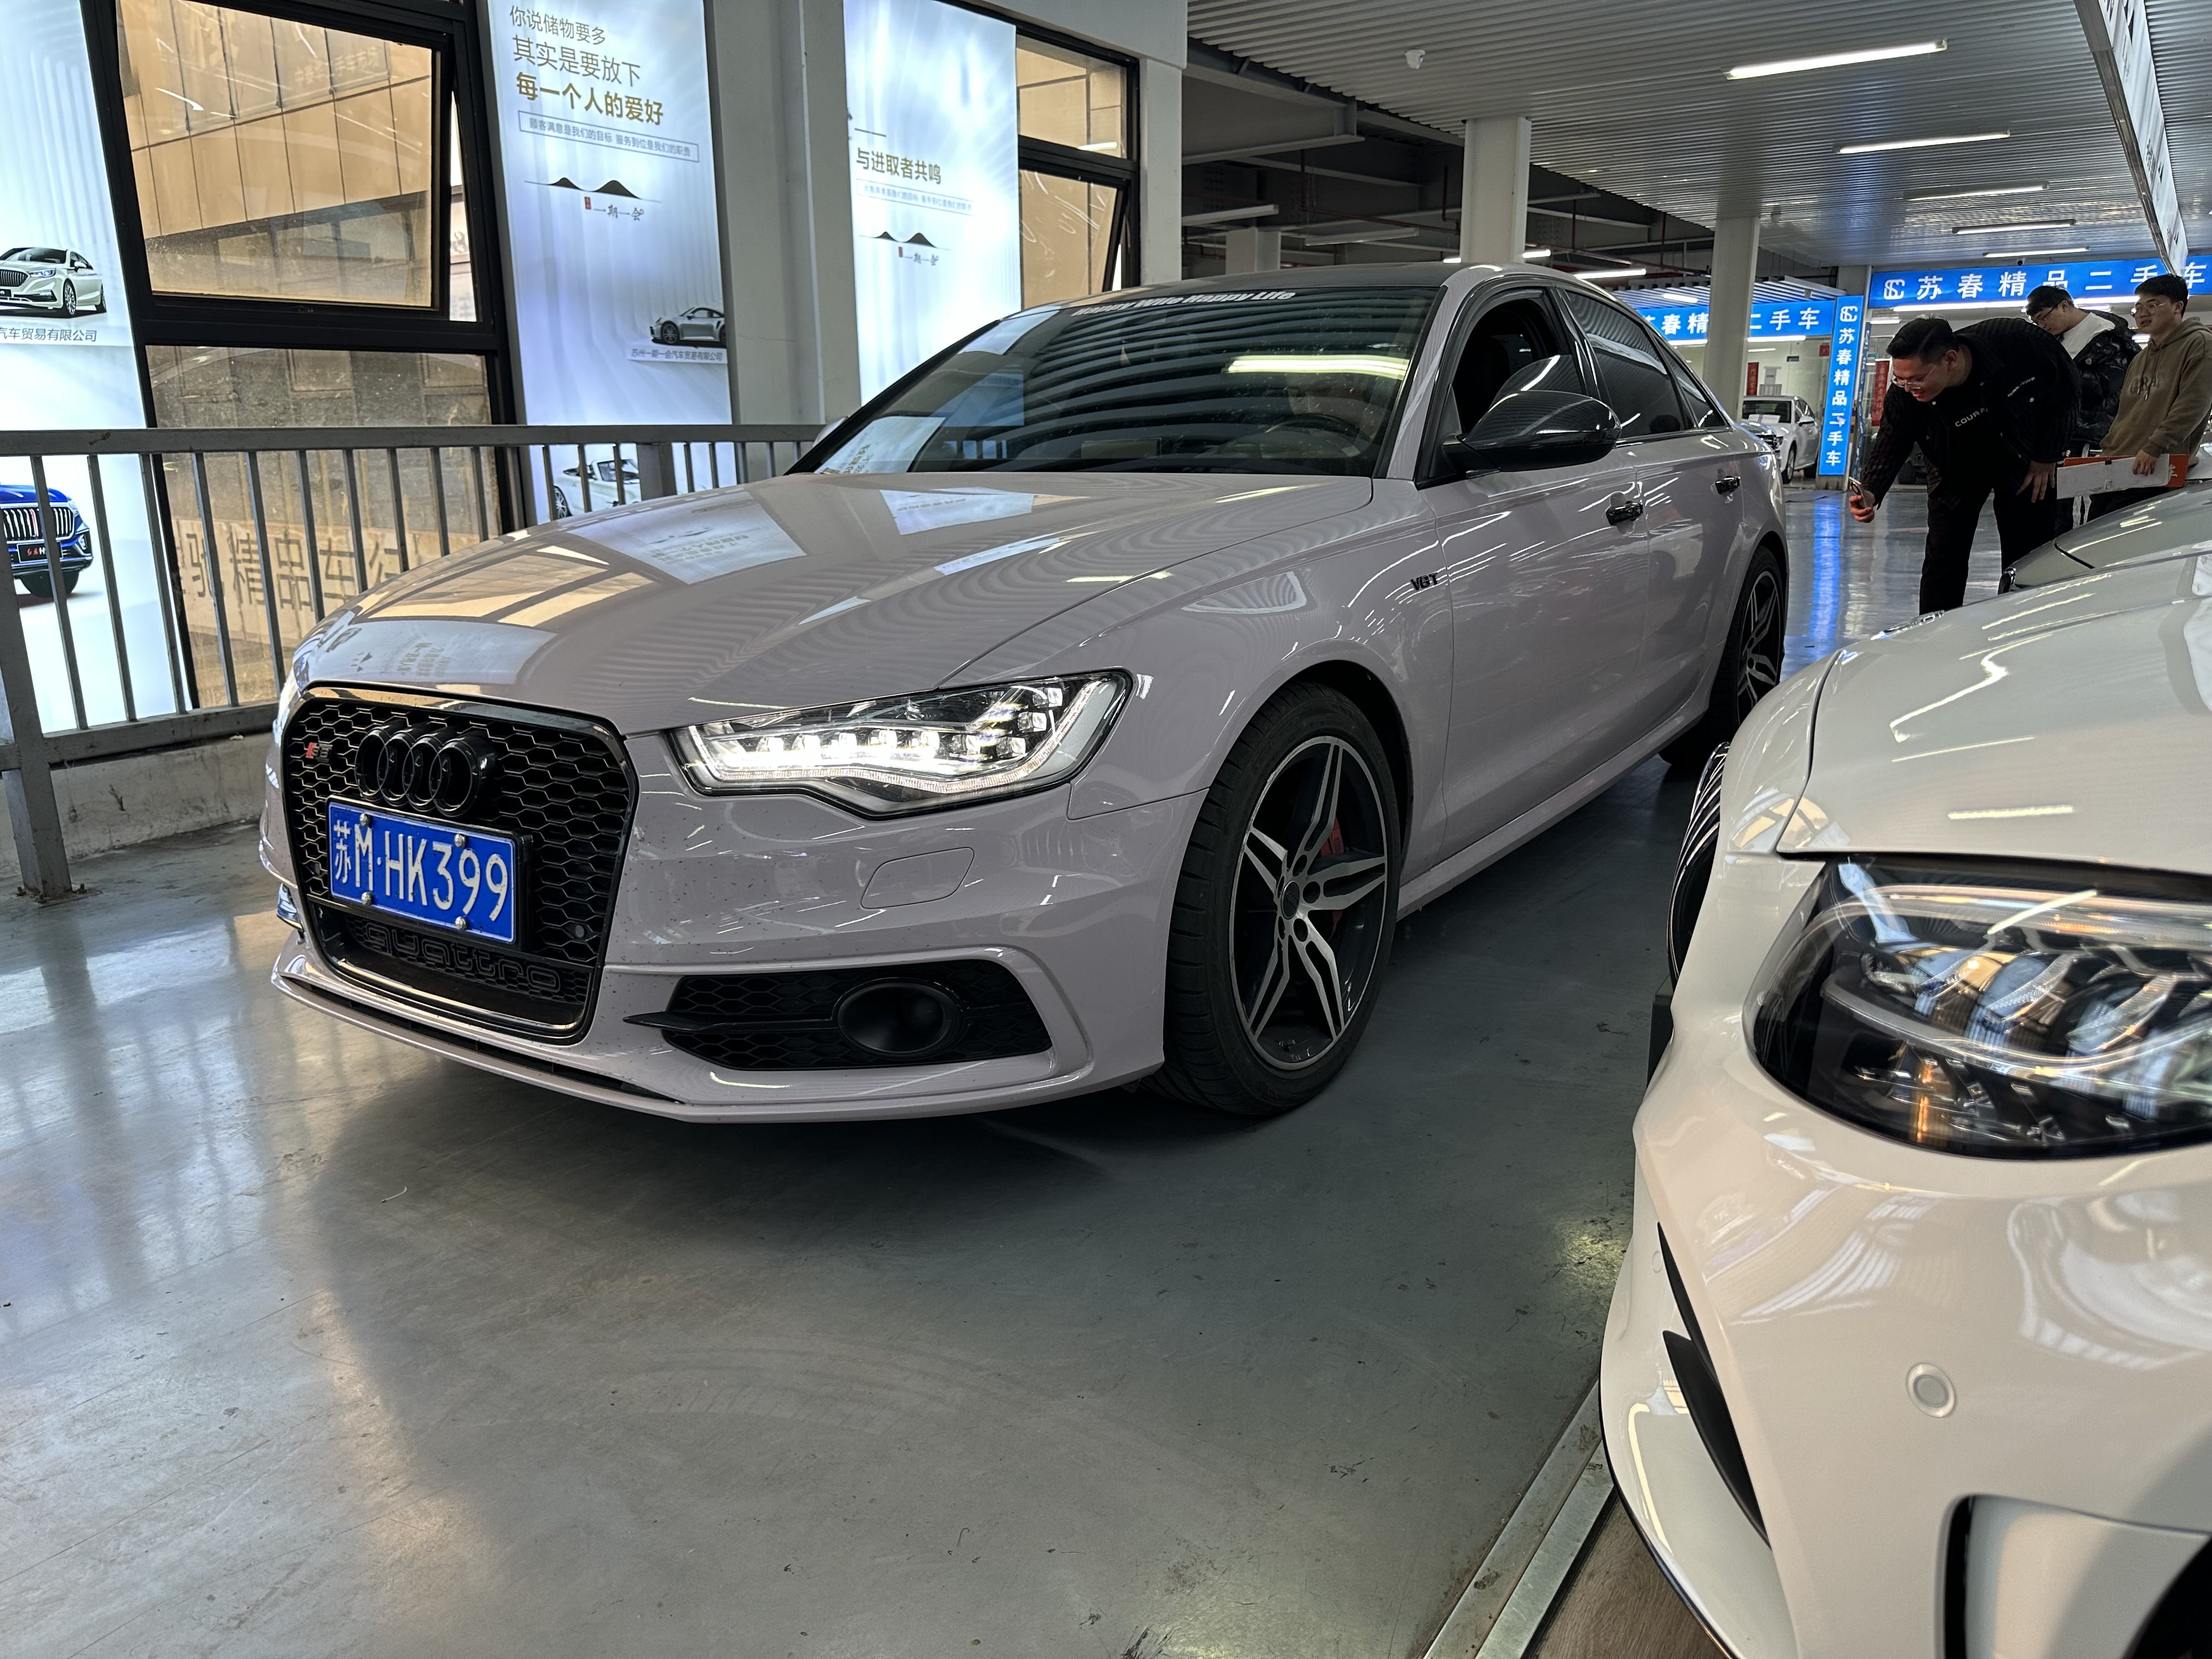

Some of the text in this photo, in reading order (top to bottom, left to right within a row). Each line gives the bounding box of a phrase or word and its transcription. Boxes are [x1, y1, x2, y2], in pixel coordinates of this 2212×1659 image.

[510, 5, 606, 45] 你说储物要多
[512, 35, 641, 87] 其实是要放下
[516, 72, 663, 126] 每一个人的爱好
[856, 147, 941, 185] 与进取者共鸣
[1071, 291, 1296, 317] Happy Wife Happy Life
[1917, 262, 2207, 300] 苏春精品二手车
[1825, 328, 1855, 466] 苏春精品二手车
[366, 922, 560, 993] quattro
